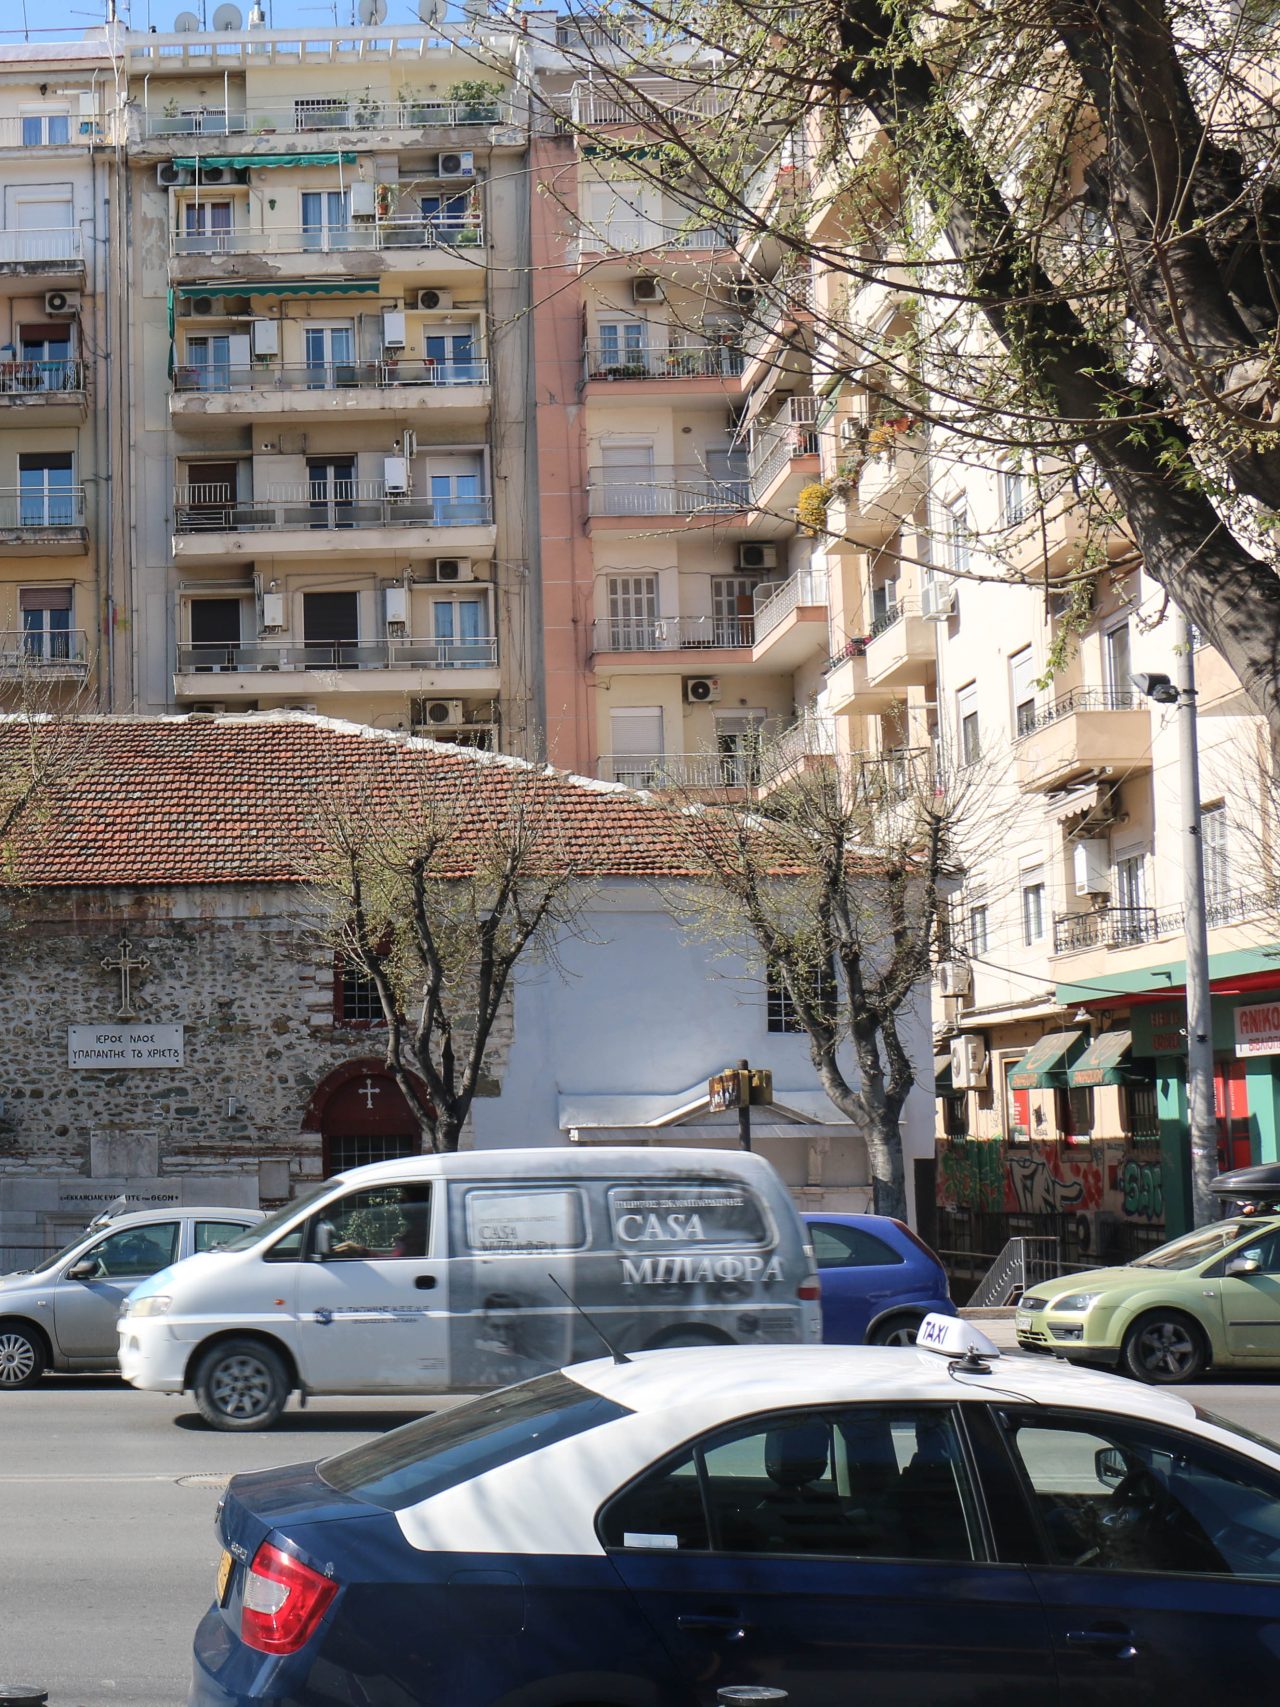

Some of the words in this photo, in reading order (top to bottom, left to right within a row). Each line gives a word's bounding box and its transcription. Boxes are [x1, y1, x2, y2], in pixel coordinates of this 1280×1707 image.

[95, 1034, 123, 1044] ΙΕΡΟΣ
[129, 1034, 156, 1043] ΝΑΟΣ
[72, 1049, 126, 1060] ΥΠΑΠΑΝΤΗΣ
[616, 1213, 707, 1242] CASA
[923, 1321, 949, 1345] TAXI
